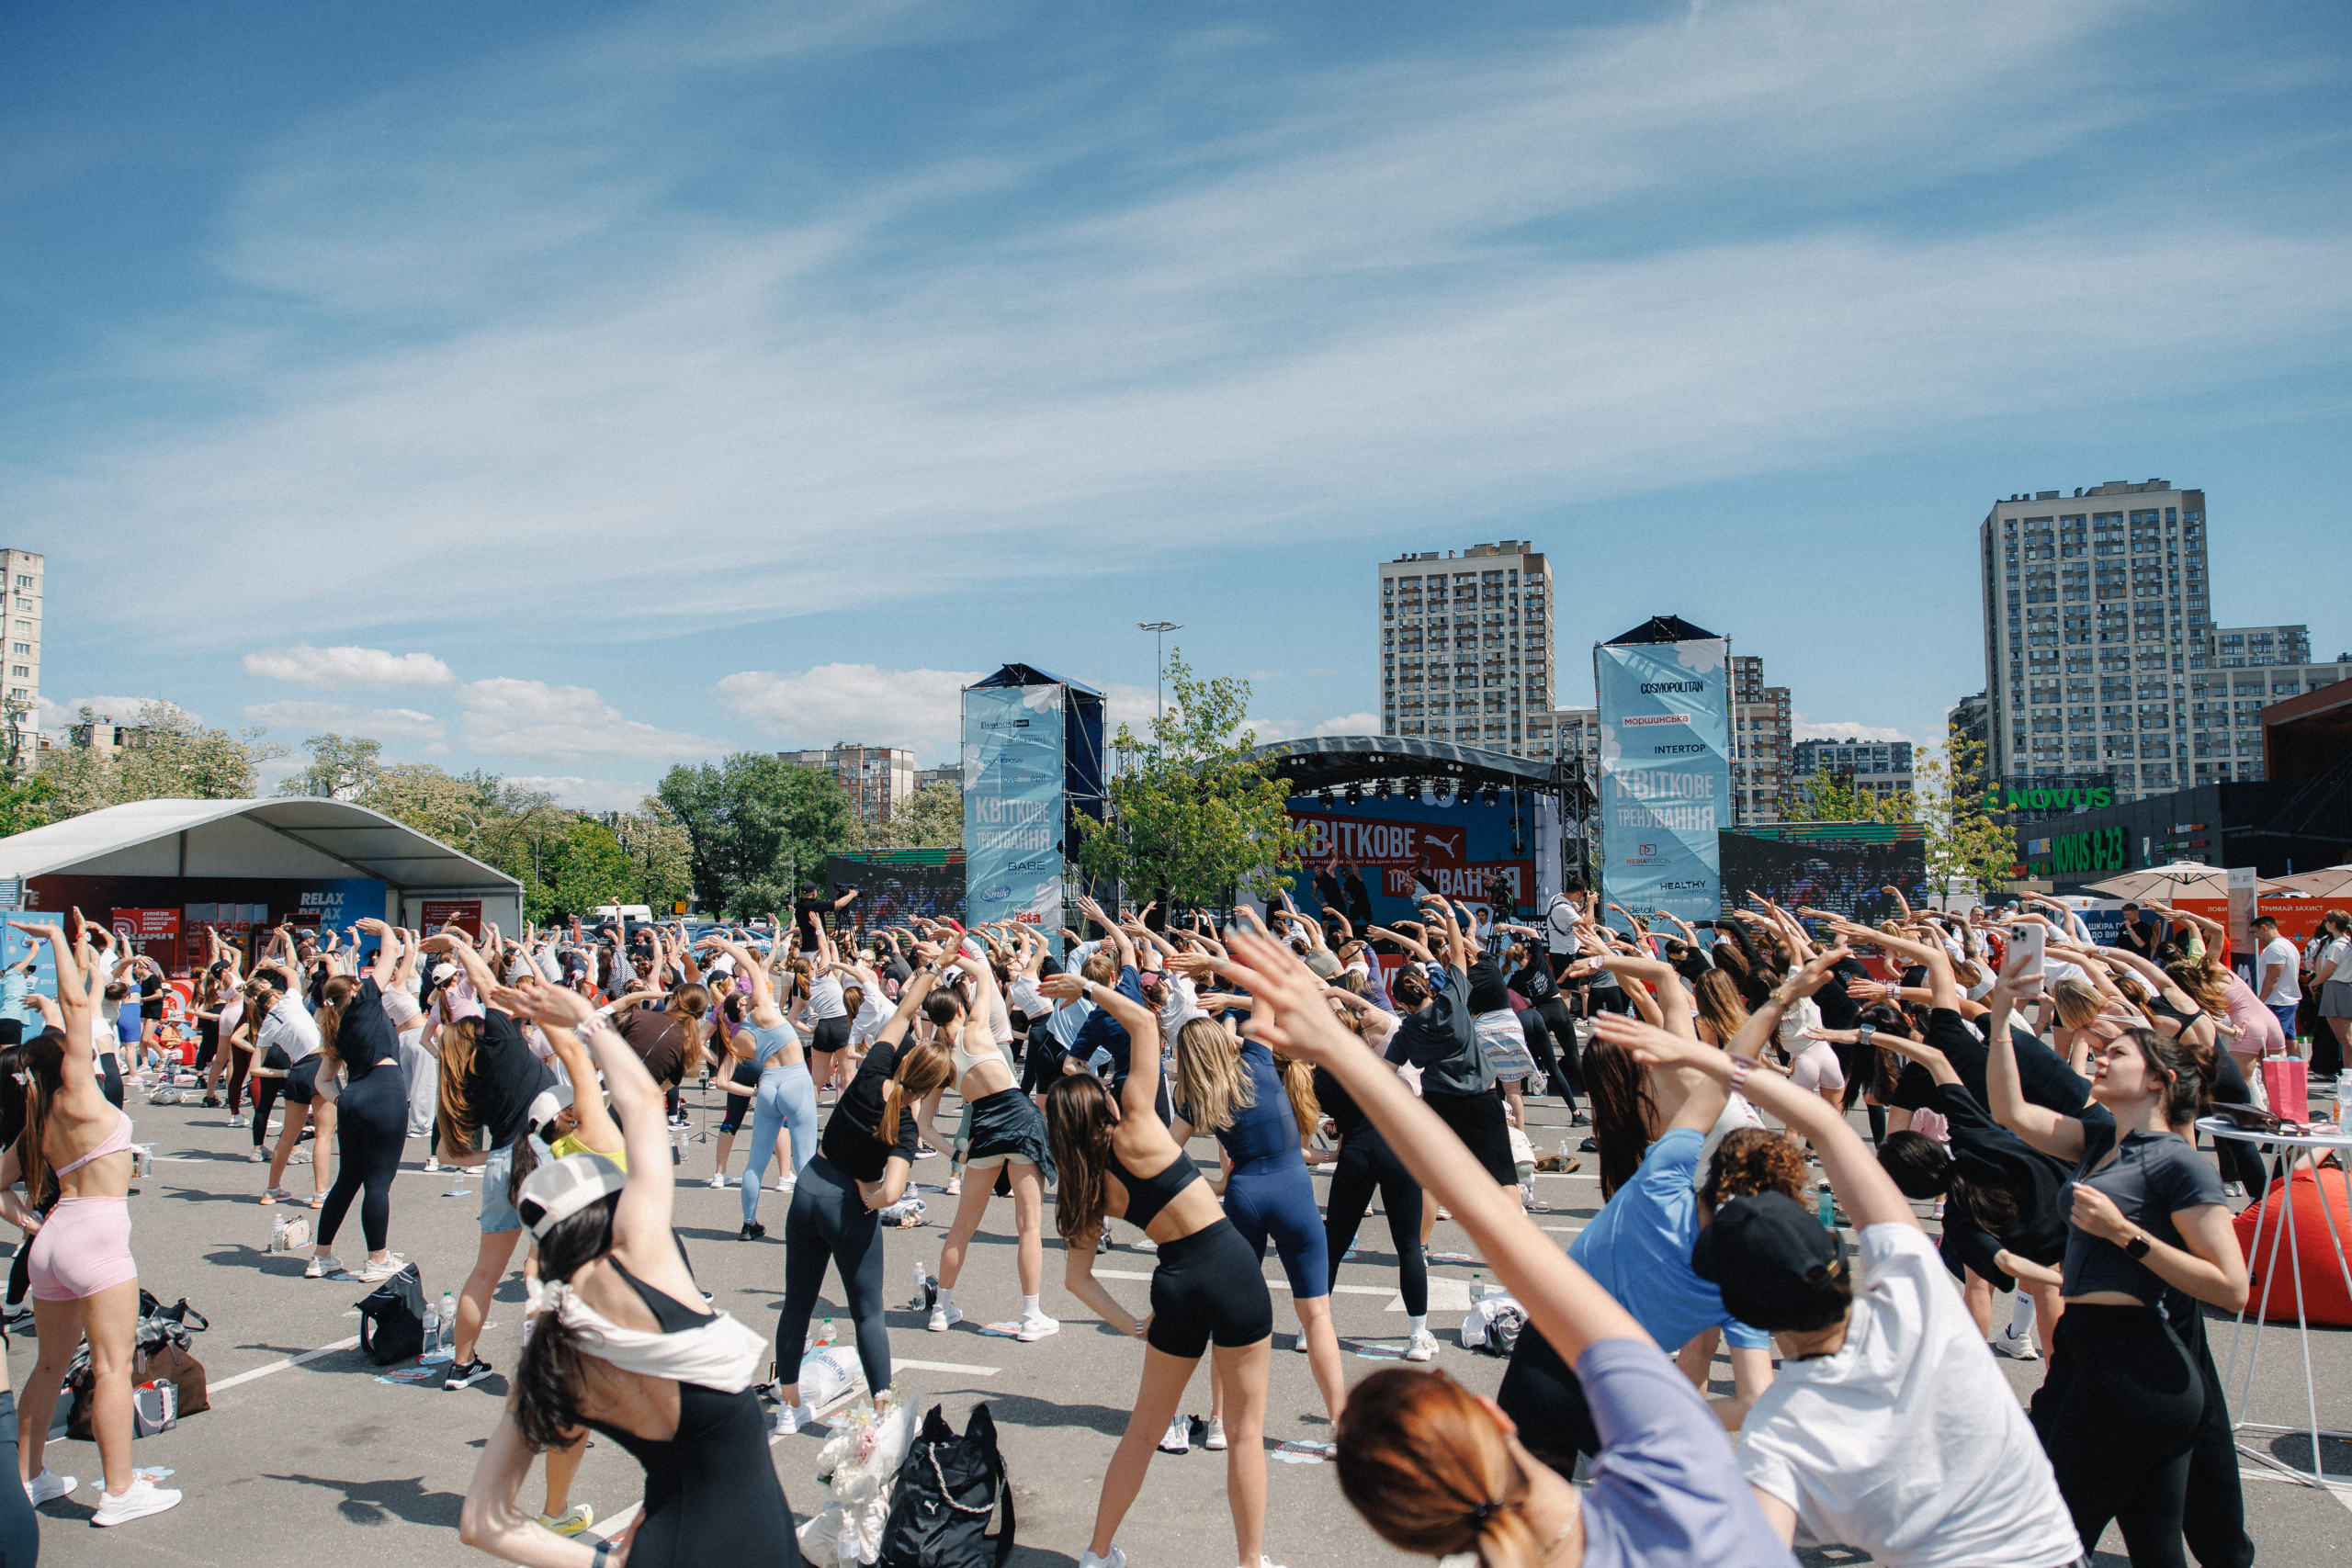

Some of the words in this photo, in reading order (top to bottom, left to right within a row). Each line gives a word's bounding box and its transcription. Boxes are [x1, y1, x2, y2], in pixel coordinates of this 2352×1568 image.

[1641, 682, 1703, 694] COSMOPOLITAN
[1624, 715, 1689, 727] моршинська
[1655, 744, 1706, 754] INTERTOP
[1001, 775, 1018, 784] love
[1030, 773, 1046, 783] epil
[1615, 768, 1714, 798] КВІТКОВЕ
[2007, 787, 2111, 809] NOVUS
[976, 795, 1050, 823] КВІТКОВЕ
[1617, 806, 1715, 831] ТРЕНУВАННЯ
[977, 829, 1050, 852] ТРЕНУВАННЯ
[1286, 818, 1416, 858] КВІТКОВЕ
[2052, 831, 2090, 873] NOVUS
[2094, 827, 2122, 871] 8-23
[1008, 862, 1046, 871] BABE
[1659, 880, 1706, 890] HEALTHY
[300, 892, 345, 906] RELAX
[982, 887, 1009, 900] Smile
[1627, 905, 1655, 914] detali
